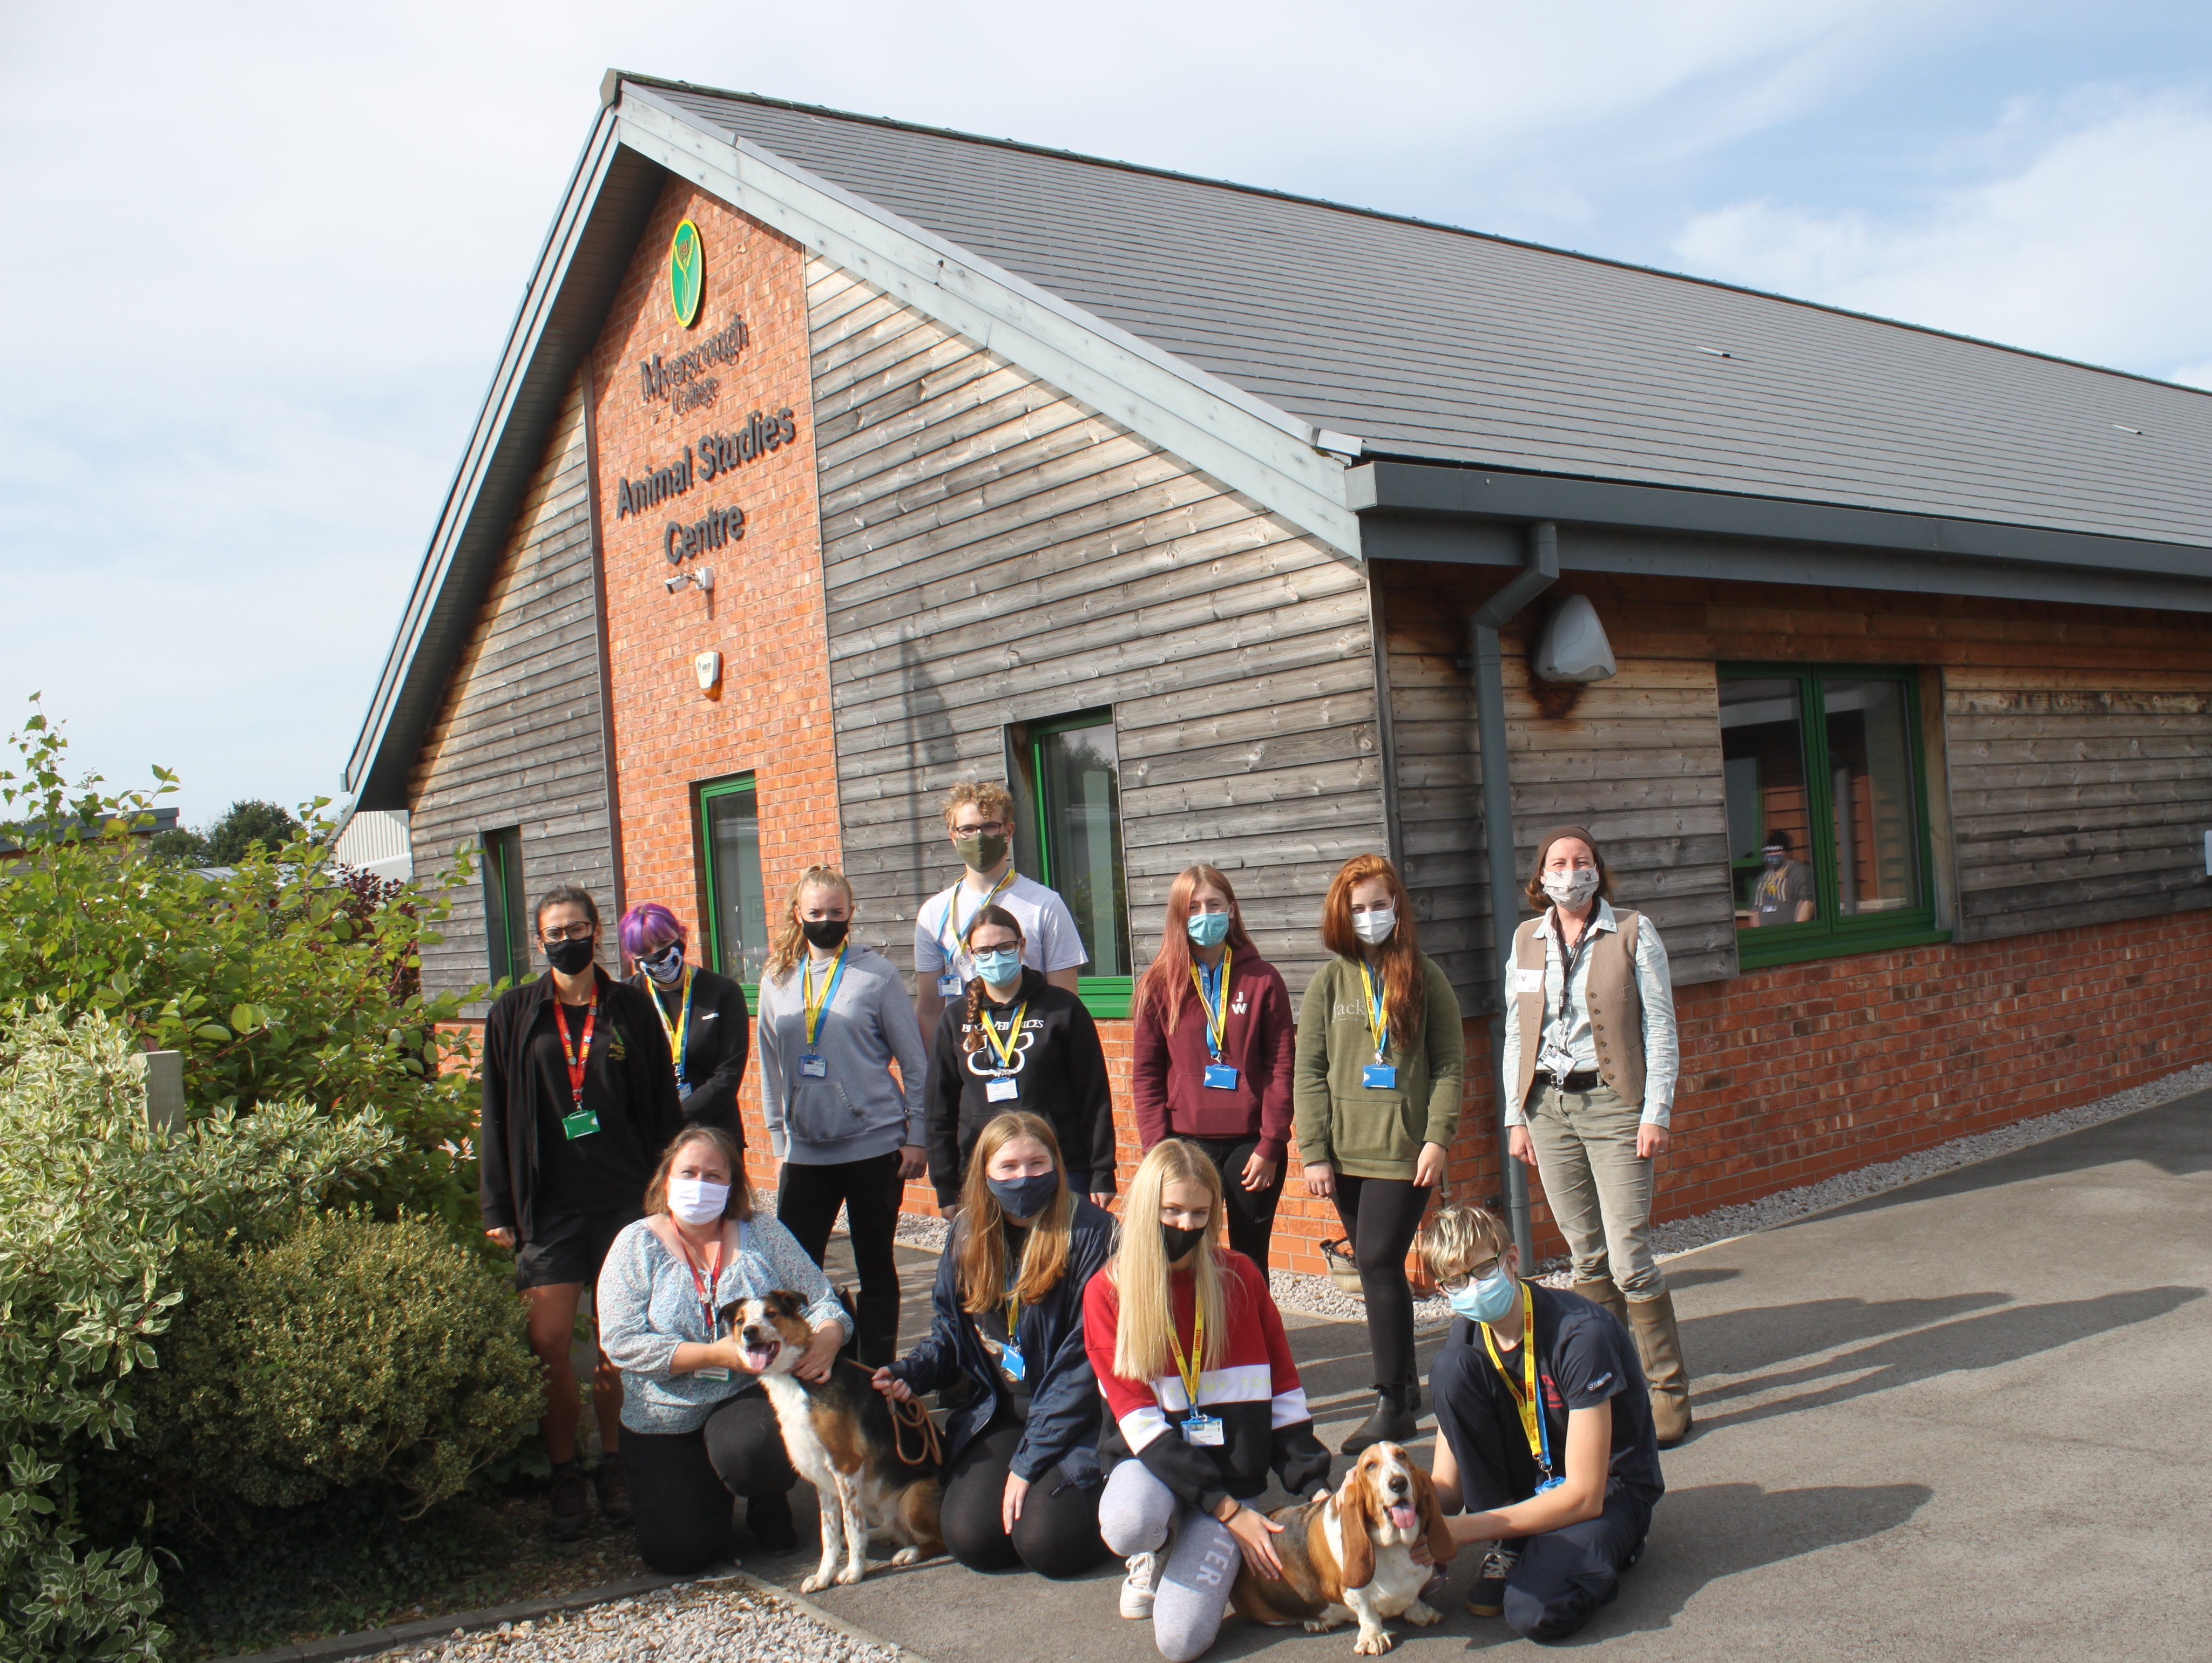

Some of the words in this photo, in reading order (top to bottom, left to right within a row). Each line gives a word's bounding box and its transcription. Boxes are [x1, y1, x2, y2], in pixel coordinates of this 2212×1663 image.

[640, 312, 748, 402] Myerscough
[672, 377, 719, 415] College
[616, 445, 692, 519] Animal
[698, 407, 795, 481] Studies
[664, 505, 744, 564] Centre
[1236, 991, 1243, 1002] J
[1232, 1003, 1248, 1015] W
[1541, 1046, 1552, 1061] STAFF
[1172, 1336, 1181, 1357] STUDENT
[1168, 1381, 1226, 1399] TOMY
